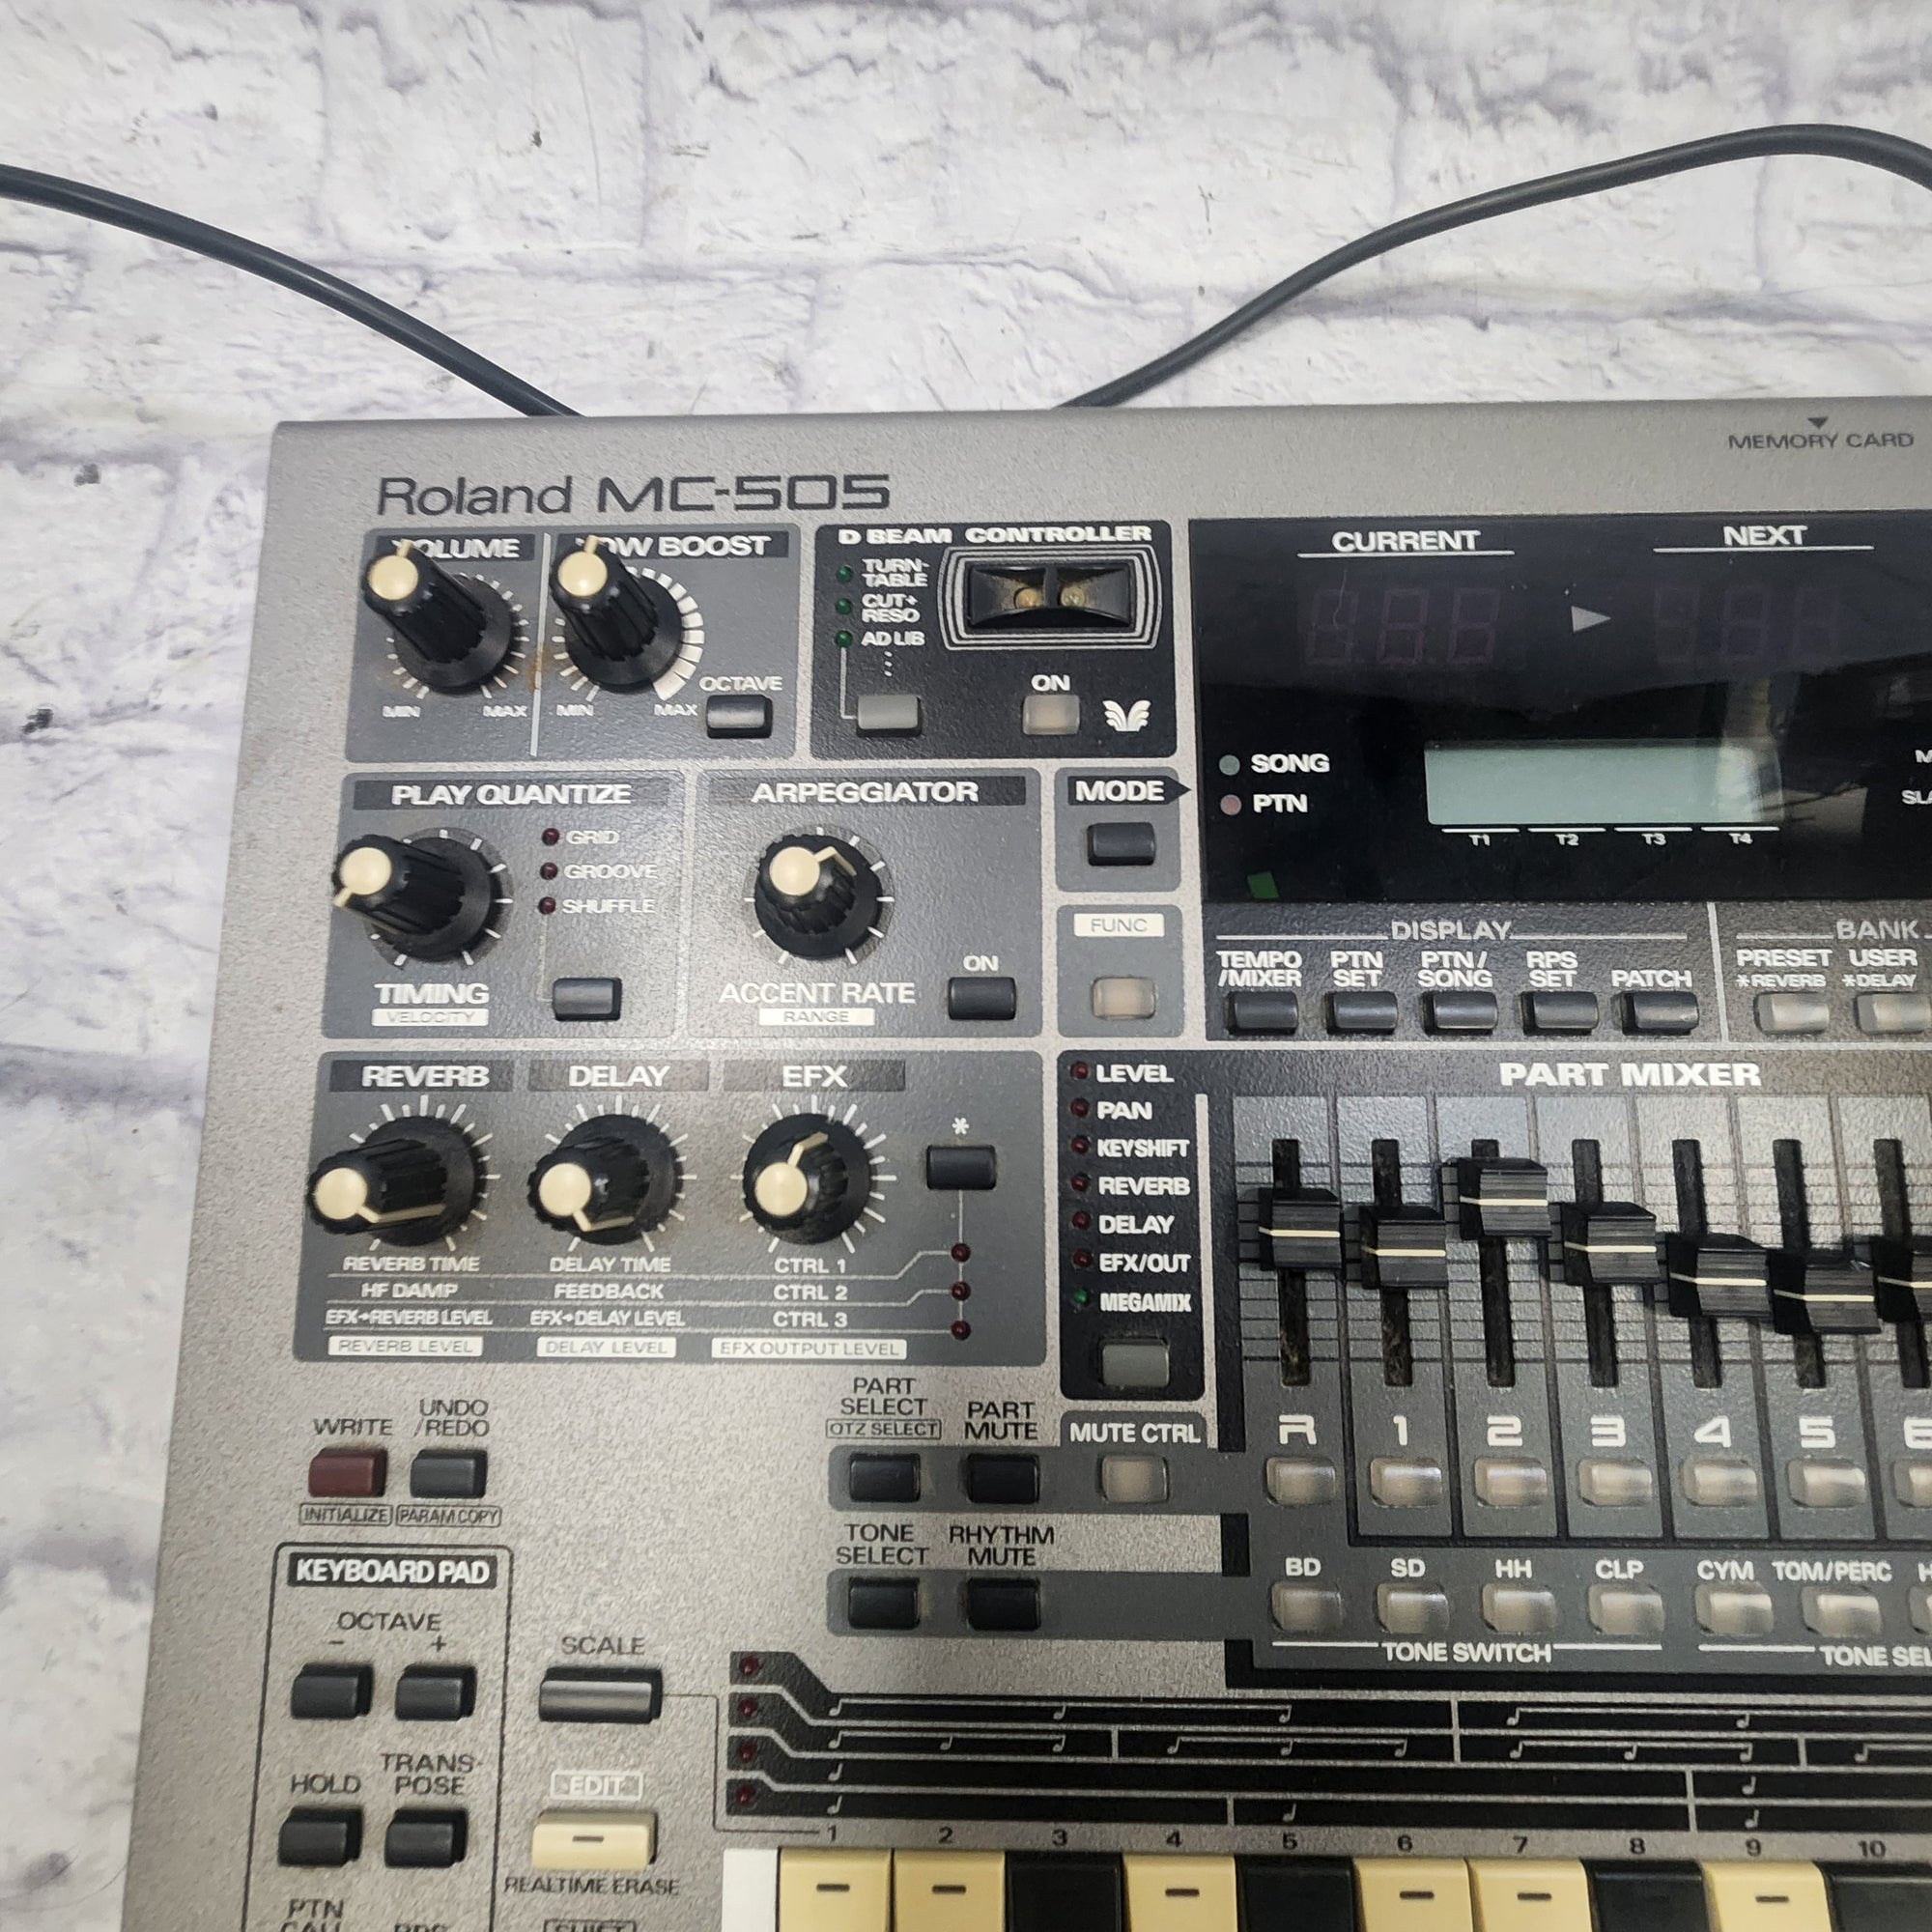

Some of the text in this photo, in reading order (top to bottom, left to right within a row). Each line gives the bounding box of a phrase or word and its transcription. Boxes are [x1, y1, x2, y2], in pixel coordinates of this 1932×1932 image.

[1728, 432, 1915, 449] MEMORY CARD
[378, 474, 891, 516] Roland MC-505
[838, 526, 1152, 546] D BEAM CONTROLLER
[1331, 530, 1481, 554] CURRENT
[1723, 525, 1808, 547] NEXT
[575, 535, 772, 557] OW BOOST
[862, 558, 930, 574] TURN-
[862, 572, 928, 588] TABLE
[862, 608, 921, 623] RESO
[861, 631, 925, 647] AD LIB
[698, 675, 783, 693] OCTAVE
[1031, 674, 1071, 693] ON
[383, 705, 421, 719] MIN
[483, 704, 527, 718] MAX
[556, 704, 595, 718] MIN
[654, 704, 698, 718] MAX
[1250, 753, 1330, 774] SONG
[390, 783, 633, 806] PLAY QUANTIZE
[751, 781, 980, 804] ARPEGGIATOR
[1075, 780, 1165, 802] MODE
[1253, 794, 1308, 815] PTN
[565, 830, 620, 846] GRID
[1468, 834, 1492, 847] T1
[1556, 833, 1580, 846] T2
[1642, 833, 1667, 846] T3
[1728, 832, 1753, 845] T4
[564, 864, 659, 880] GROOVE
[562, 899, 656, 915] SHUFFLE
[1091, 917, 1149, 934] FUNC
[1391, 920, 1512, 942] DISPLAY
[1836, 919, 1919, 941] BANK
[963, 954, 1000, 973] ON
[1216, 950, 1303, 969] TEMPO
[1330, 951, 1383, 970] PTN
[1421, 950, 1489, 970] PTN/
[1526, 951, 1579, 969] RPS
[1737, 948, 1833, 967] PRESET
[1849, 948, 1918, 967] USER
[1217, 968, 1303, 988] /MIXER
[1333, 968, 1382, 988] SET
[1417, 968, 1494, 988] SONG
[1530, 968, 1577, 988] SET
[1611, 969, 1693, 988] PATCH
[373, 981, 491, 1006] TIMING
[719, 981, 917, 1005] ACCENT RATE
[386, 1010, 477, 1025] VELOCITY
[783, 1009, 851, 1024] RANGE
[361, 1065, 491, 1088] REVERB
[568, 1065, 670, 1088] DELAY
[781, 1065, 848, 1089] EFX
[1096, 1064, 1176, 1084] LEVEL
[1500, 1063, 1763, 1087] PART MIXER
[1096, 1101, 1153, 1121] PAN
[1097, 1138, 1191, 1158] KEYSHIFT
[1098, 1176, 1191, 1196] REVERB
[1098, 1214, 1176, 1235] DELAY
[343, 1257, 481, 1272] REVERB TIME
[550, 1257, 672, 1272] DELAY TIME
[774, 1258, 846, 1274] CTRL 1
[1099, 1253, 1192, 1273] EFX/OUT
[361, 1283, 459, 1298] HF DAMP
[554, 1283, 666, 1299] FEEDBACK
[773, 1284, 849, 1301] CTRL 2
[1100, 1293, 1192, 1312] MEGAMIX
[440, 1310, 494, 1325] LEVEL
[634, 1310, 687, 1327] LEVEL
[773, 1311, 849, 1328] CTRL 3
[338, 1339, 473, 1353] REVERB LEVEL
[545, 1341, 668, 1354] DELAY LEVEL
[720, 1342, 900, 1356] EFX OUTPUT LEVEL
[854, 1378, 917, 1394] PART
[419, 1399, 489, 1417] UNDO
[839, 1398, 927, 1416] SELECT
[969, 1402, 1037, 1418] PART
[314, 1419, 392, 1436] WRITE
[413, 1419, 490, 1437] /REDO
[870, 1422, 938, 1437] SELECT
[966, 1422, 1038, 1439] MUTE
[1070, 1422, 1201, 1443] MUTE CTRL
[1393, 1415, 1408, 1446] 1
[1487, 1416, 1523, 1447] 2
[1590, 1415, 1626, 1447] 3
[1693, 1415, 1732, 1448] 4
[1799, 1416, 1835, 1448] 5
[304, 1507, 387, 1523] INITIALIZE
[399, 1508, 498, 1525] PARAM COPY
[846, 1523, 914, 1542] TONE
[950, 1525, 1054, 1545] RHYTHM
[836, 1548, 929, 1565] SELECT
[968, 1547, 1037, 1566] MUTE
[297, 1559, 490, 1584] KEYBOARD PAD
[1285, 1557, 1321, 1577] BD
[1391, 1558, 1426, 1577] SD
[1496, 1559, 1533, 1579] HH
[1595, 1560, 1644, 1579] CLP
[1696, 1560, 1754, 1581] CYM
[1772, 1561, 1892, 1581] TOM/PERC
[337, 1611, 441, 1631] OCTAVE
[561, 1636, 646, 1656] SCALE
[1381, 1642, 1551, 1662] TONE SWITCH
[1819, 1646, 1888, 1666] TONE
[291, 1775, 362, 1793] HOLD
[394, 1775, 466, 1794] POSE
[569, 1776, 624, 1794] EDIT
[827, 1827, 838, 1841] 1
[940, 1828, 953, 1843] 2
[1053, 1829, 1067, 1845] 3
[1166, 1831, 1181, 1846] 4
[1282, 1833, 1297, 1849] 5
[1398, 1835, 1412, 1852] 6
[1515, 1837, 1527, 1853] 7
[1630, 1838, 1645, 1855] 8
[1747, 1840, 1761, 1857] 9
[1858, 1841, 1886, 1858] 10
[504, 1877, 680, 1896] REALTIME ERASE
[288, 1898, 344, 1918] PTN
